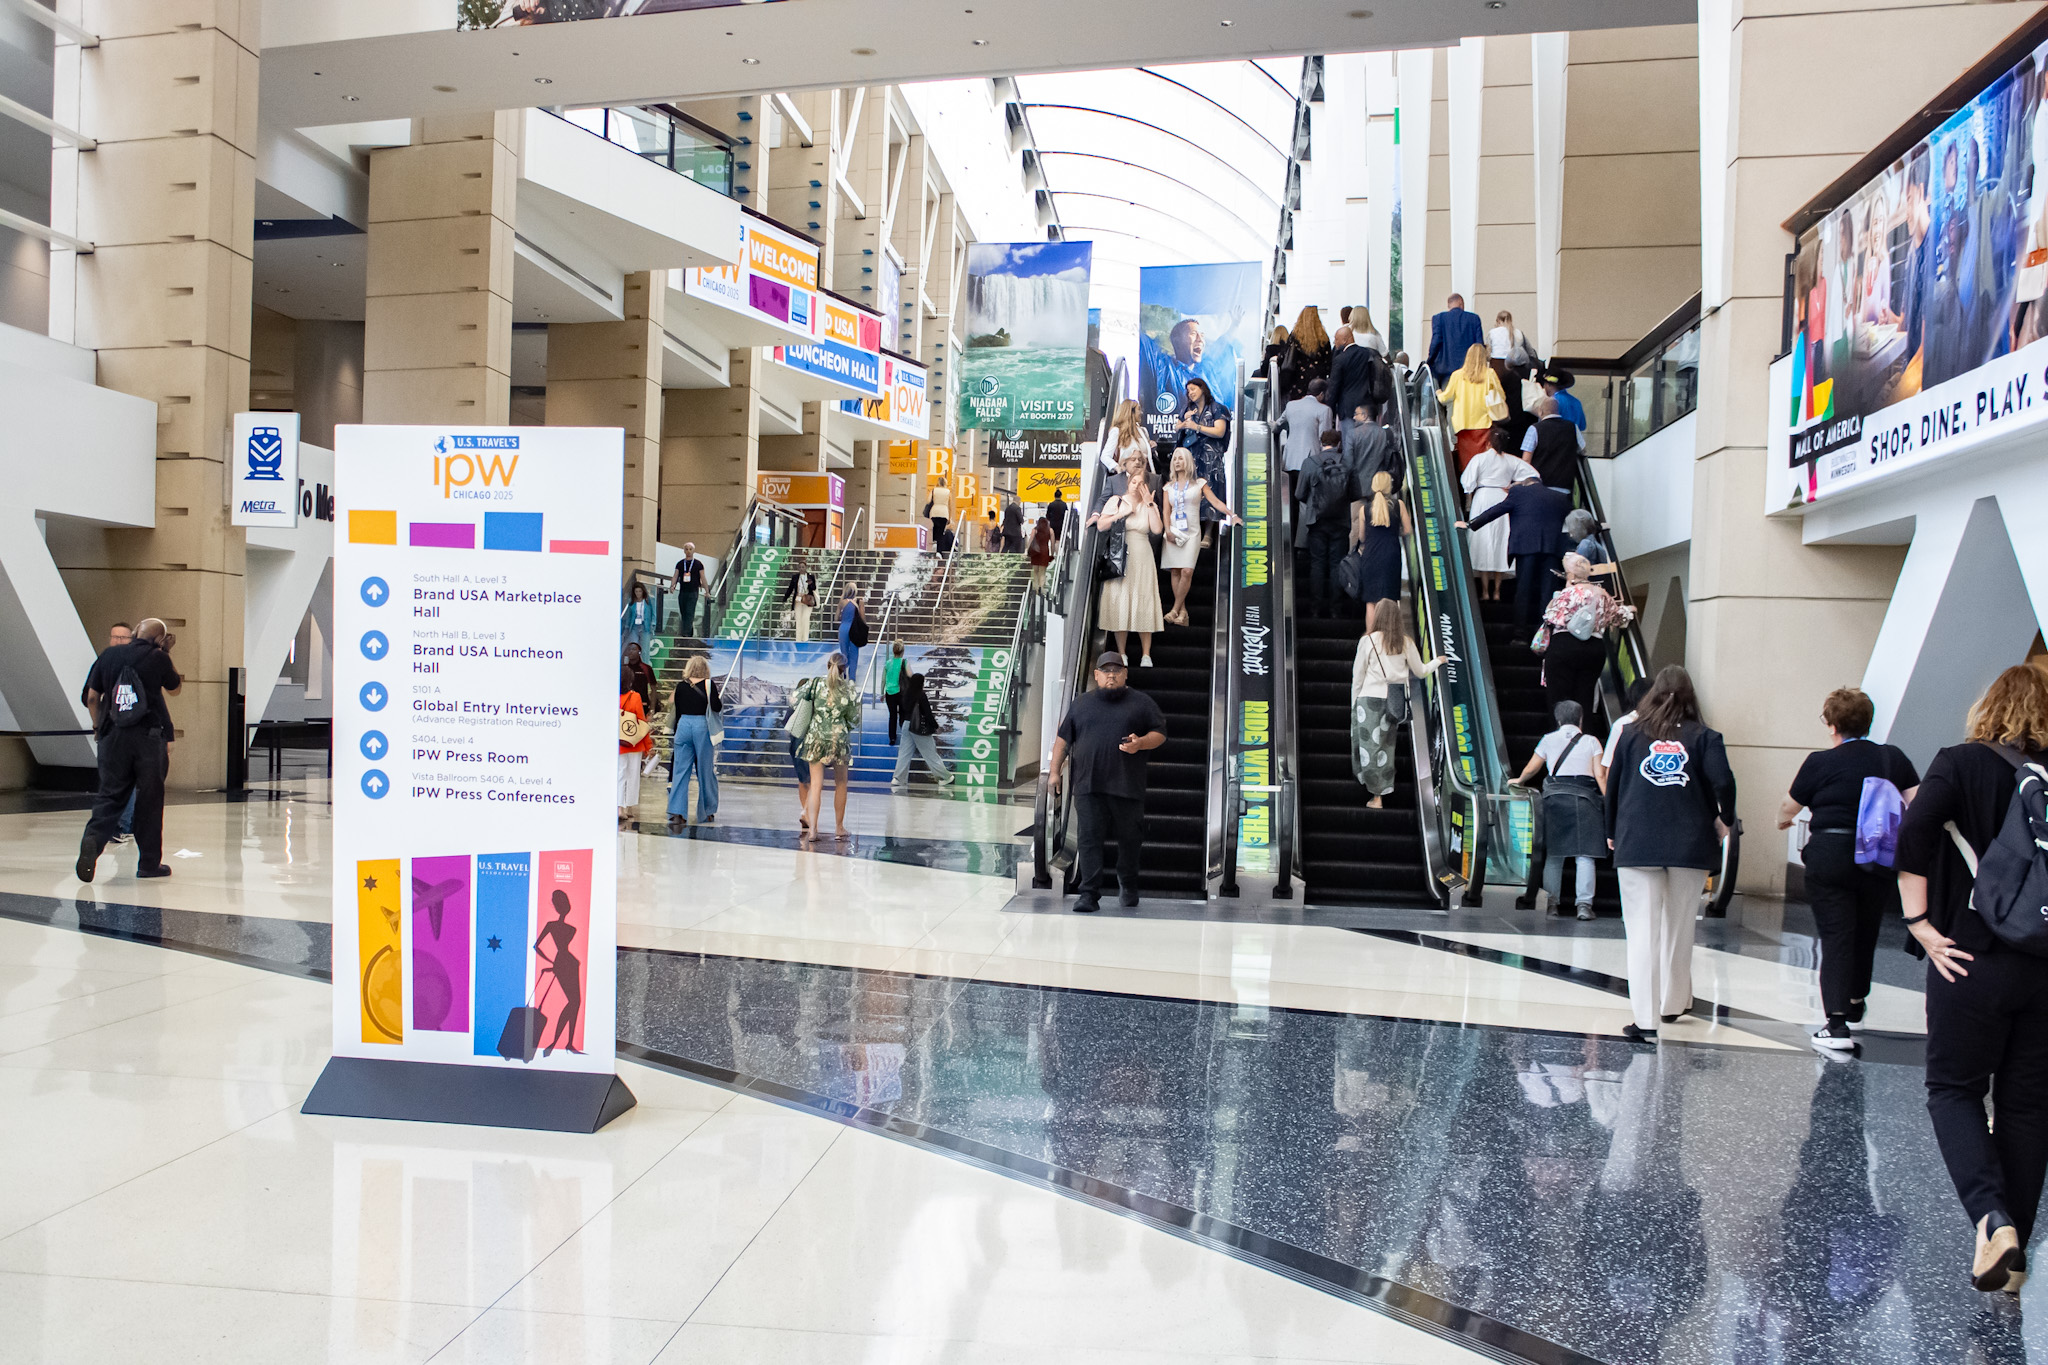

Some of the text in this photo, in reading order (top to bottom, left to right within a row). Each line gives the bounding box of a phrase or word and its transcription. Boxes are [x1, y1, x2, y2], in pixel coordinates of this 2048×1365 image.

[750, 238, 815, 286] WELCOME
[702, 277, 726, 295] CHICAGO
[834, 317, 855, 340] USA
[788, 345, 878, 386] LUNCHEON HALL
[893, 385, 924, 422] ipw
[970, 397, 1007, 408] NIAGARA
[1020, 400, 1074, 411] VISIT US
[976, 407, 1001, 418] FALLS
[1870, 422, 1912, 465] SHOP.
[1920, 401, 1967, 447] DINE.
[1976, 373, 2032, 426] PLAY.
[1813, 429, 1825, 451] OF
[1825, 414, 1861, 447] AMERICA
[457, 437, 517, 448] U.S. TRAVEL'S
[997, 440, 1029, 450] NIAGARA
[1040, 443, 1068, 453] VISIT
[1002, 449, 1024, 459] FALLS
[927, 449, 949, 475] B
[1245, 453, 1267, 481] RIDE
[434, 453, 519, 499] ipw
[762, 483, 790, 498] ipw
[956, 475, 976, 499] B
[298, 478, 313, 518] To
[453, 490, 513, 500] CHICAGO 2025
[1245, 484, 1267, 518] WITH
[240, 500, 276, 513] Metra
[1244, 520, 1268, 547] THE
[413, 574, 440, 583] South
[443, 574, 460, 583] Hall
[475, 575, 498, 584] Level
[501, 575, 507, 584] 3
[414, 588, 582, 604] Brand USA Marketplace
[414, 606, 440, 618] Hall
[413, 630, 439, 639] North
[442, 630, 458, 639] Hall
[473, 632, 497, 640] Level
[500, 632, 505, 640] 3
[1241, 606, 1270, 675] VISIT Detroit
[413, 644, 563, 659] Brand USA Luncheon
[413, 661, 439, 673] Hall
[412, 685, 441, 694] S101 A
[413, 700, 579, 716] Global Entry Interviews
[412, 714, 562, 728] (Advance Registration Required)
[966, 650, 1010, 784] OREGON
[1242, 700, 1269, 744] RIDE
[441, 736, 465, 744] Level
[468, 736, 474, 744] 4
[412, 749, 529, 764] IPW Press Room
[1655, 755, 1676, 770] 66
[412, 772, 434, 781] Vista
[437, 773, 477, 783] Ballroom
[480, 775, 504, 784] S406
[519, 776, 543, 785] Level
[546, 777, 552, 785] 4
[1242, 748, 1269, 802] WITH
[412, 786, 575, 804] IPW Press Conferences
[1241, 804, 1269, 846] THE
[478, 861, 530, 872] U.S. TRAVEL
